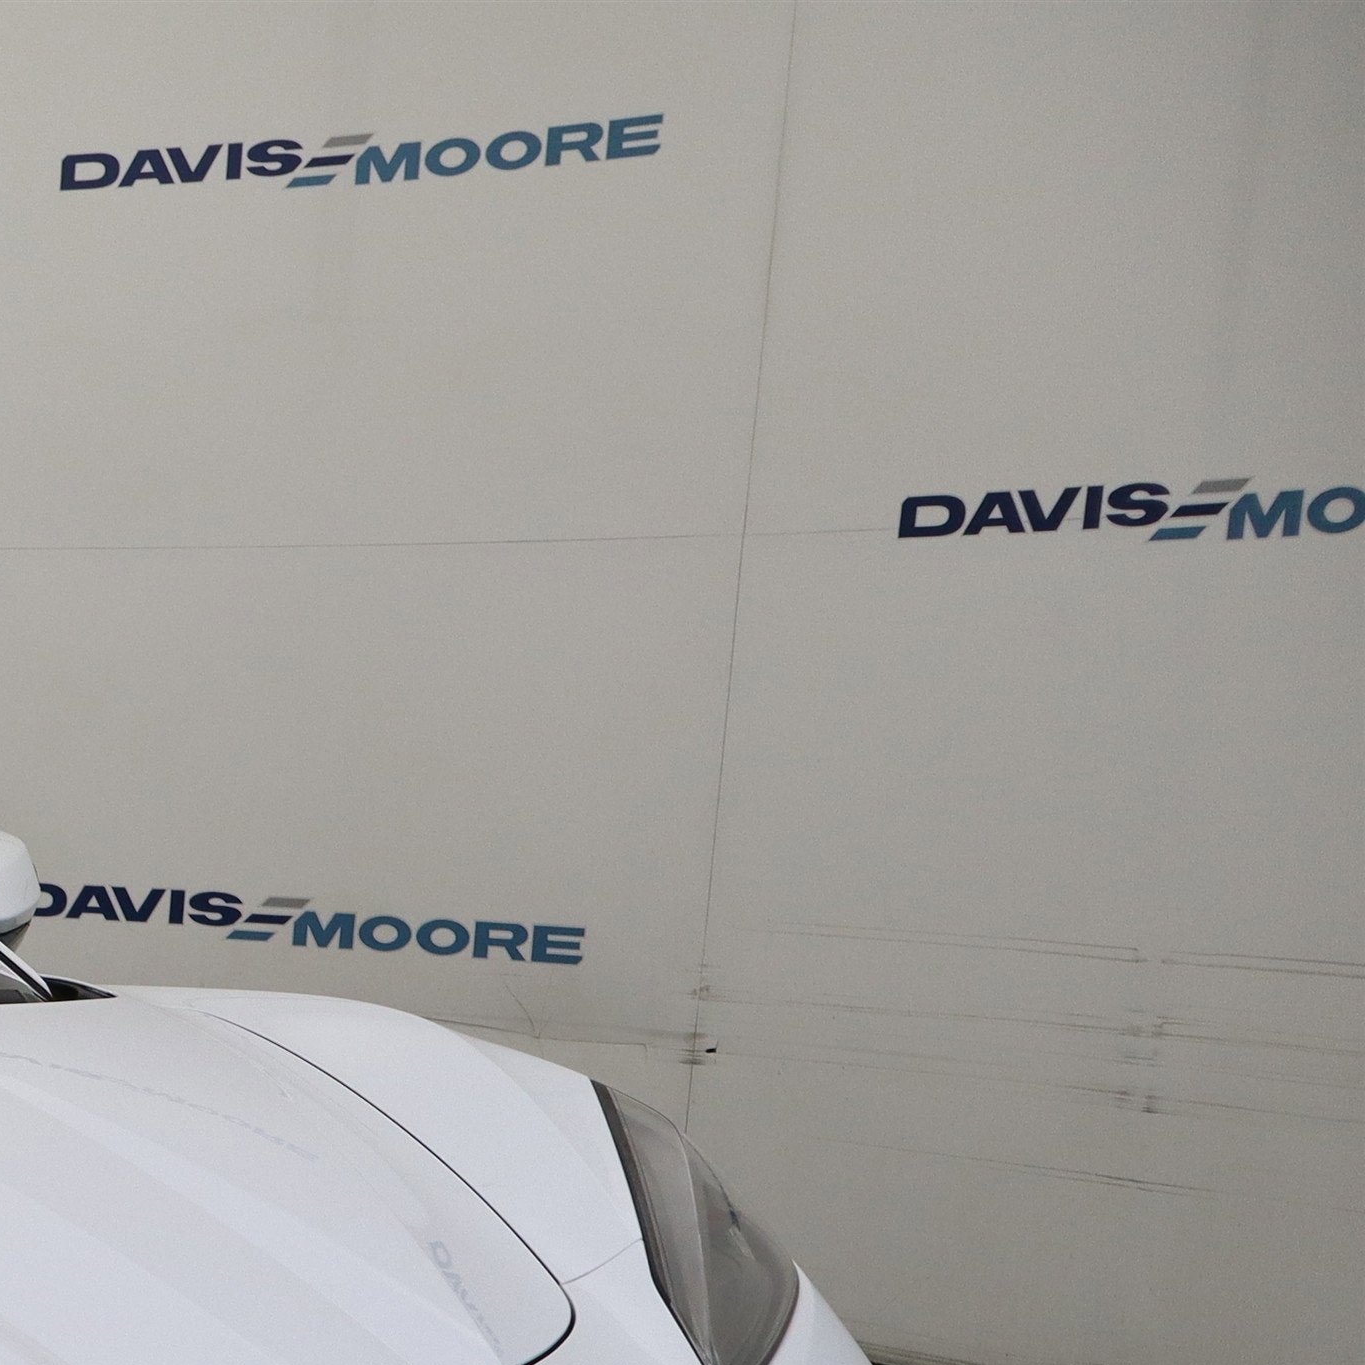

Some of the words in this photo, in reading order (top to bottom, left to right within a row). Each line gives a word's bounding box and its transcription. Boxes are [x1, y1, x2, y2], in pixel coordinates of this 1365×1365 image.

[60, 138, 304, 192] DAVIS
[355, 113, 664, 186] MOORE
[898, 482, 1171, 538] DAVIS
[33, 883, 243, 927] DAVIS
[293, 910, 586, 965] MOORE
